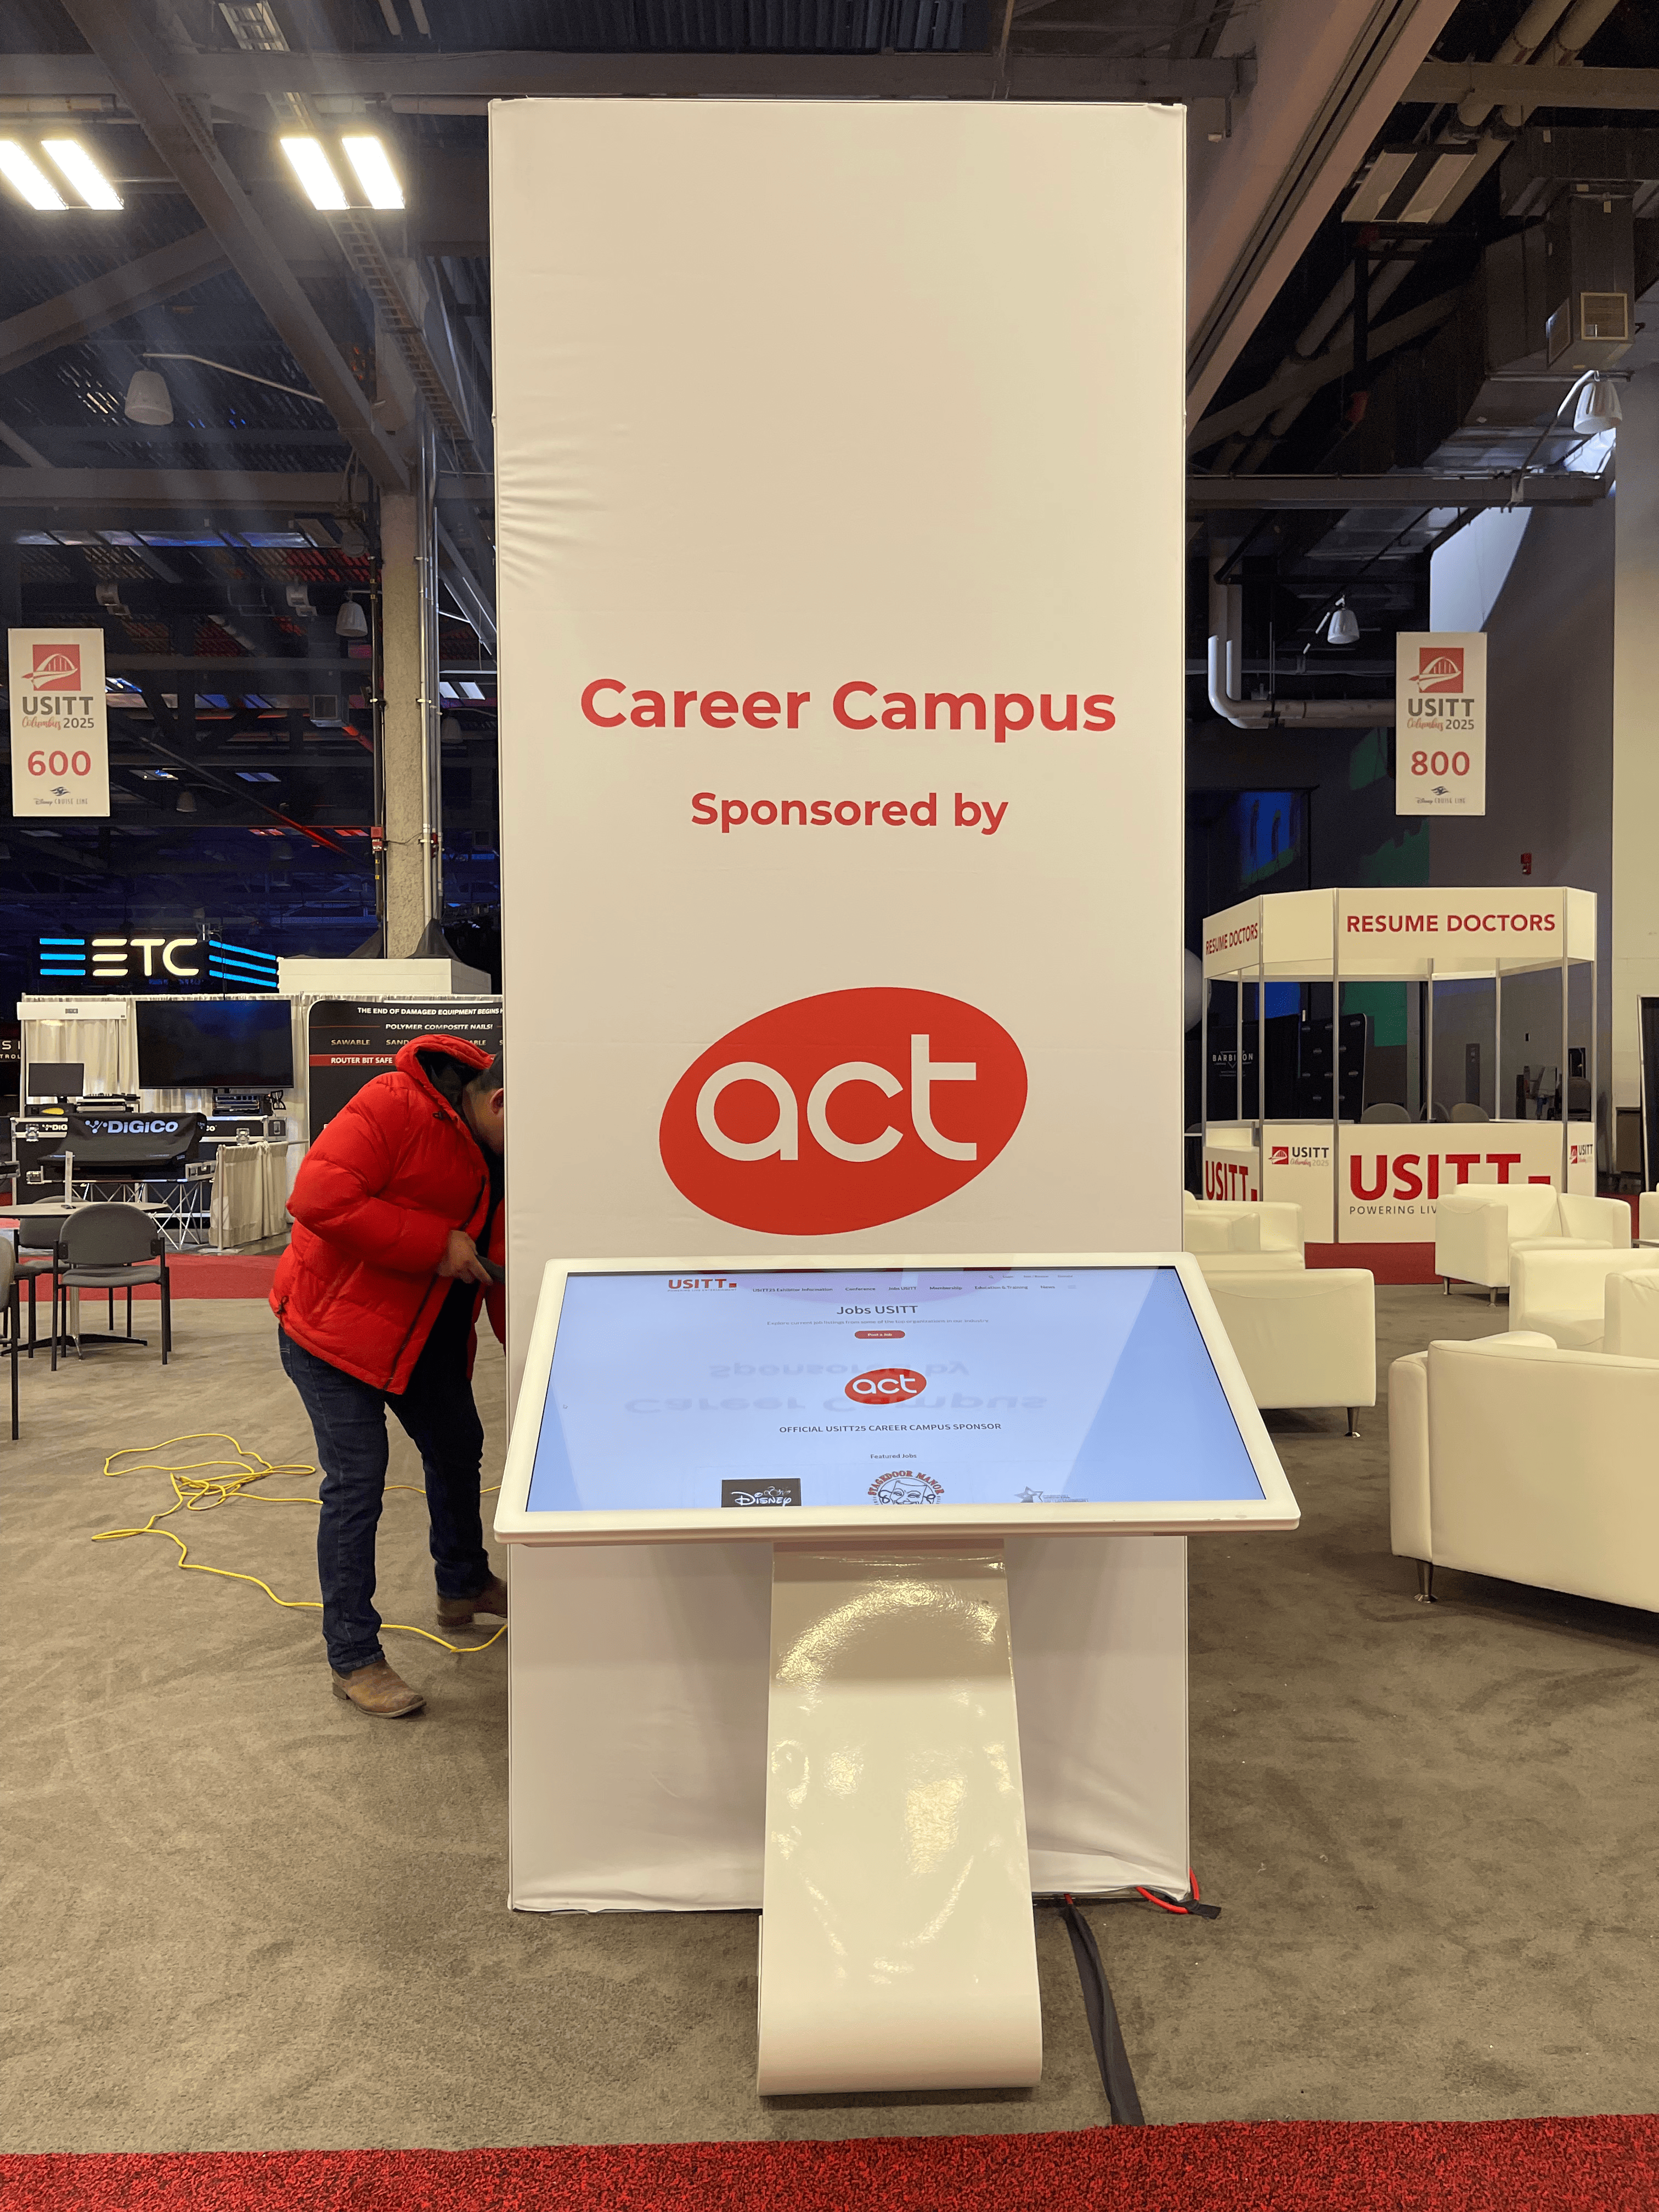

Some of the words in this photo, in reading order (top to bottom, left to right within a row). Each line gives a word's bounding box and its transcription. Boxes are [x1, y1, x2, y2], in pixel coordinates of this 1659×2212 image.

[22, 696, 93, 715] USITT
[580, 678, 810, 729] Career
[832, 681, 1116, 743] Campus
[1408, 698, 1475, 716] USITT
[22, 716, 61, 730] Columbus
[64, 718, 94, 728] 2025
[1407, 718, 1443, 732] Columbus
[1446, 719, 1474, 730] 2025
[27, 750, 91, 776] 600
[1411, 751, 1470, 776] 800
[1415, 797, 1433, 805] Disney
[691, 792, 937, 833] Sponsored
[955, 792, 1009, 835] by
[1347, 915, 1438, 933] RESUME
[1447, 914, 1555, 932] DOCTORS
[1206, 934, 1227, 955] RESUME
[1229, 923, 1258, 947] DOCTORS
[92, 939, 199, 976] ETC
[1212, 1053, 1253, 1062] BARBION
[696, 1034, 977, 1163] act
[1292, 1147, 1329, 1158] USITT
[1578, 1144, 1593, 1155] USITT
[1350, 1206, 1414, 1215] POWERING
[1420, 1205, 1437, 1214] LIV
[669, 1279, 726, 1289] USITT
[837, 1306, 871, 1314] Jobs
[875, 1305, 918, 1314] USITT
[852, 1374, 917, 1394] act
[915, 1472, 945, 1495] MANOR
[731, 1491, 792, 1506] Disney
